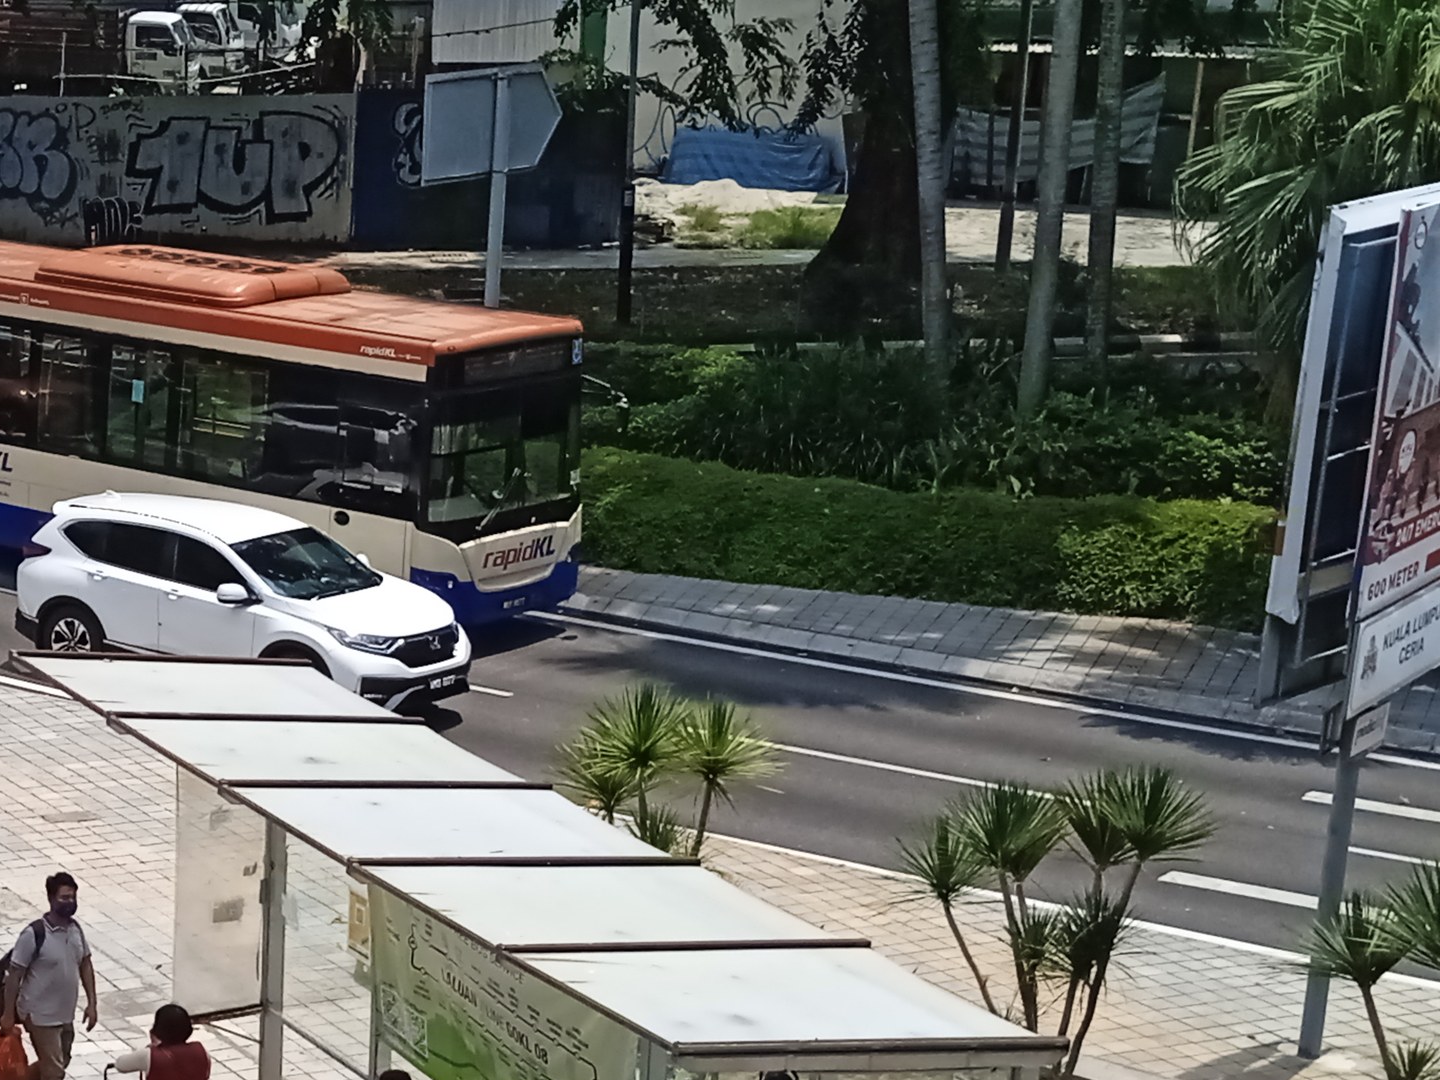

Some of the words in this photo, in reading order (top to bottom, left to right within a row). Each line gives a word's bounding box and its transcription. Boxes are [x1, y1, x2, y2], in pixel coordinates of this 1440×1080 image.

[124, 110, 340, 225] 1UP
[1415, 510, 1440, 538] EMER
[482, 534, 556, 571] rapidKL
[1367, 577, 1387, 601] 600
[1388, 561, 1420, 591] METER
[1382, 620, 1411, 651] KUALA
[1398, 636, 1425, 665] CERIA
